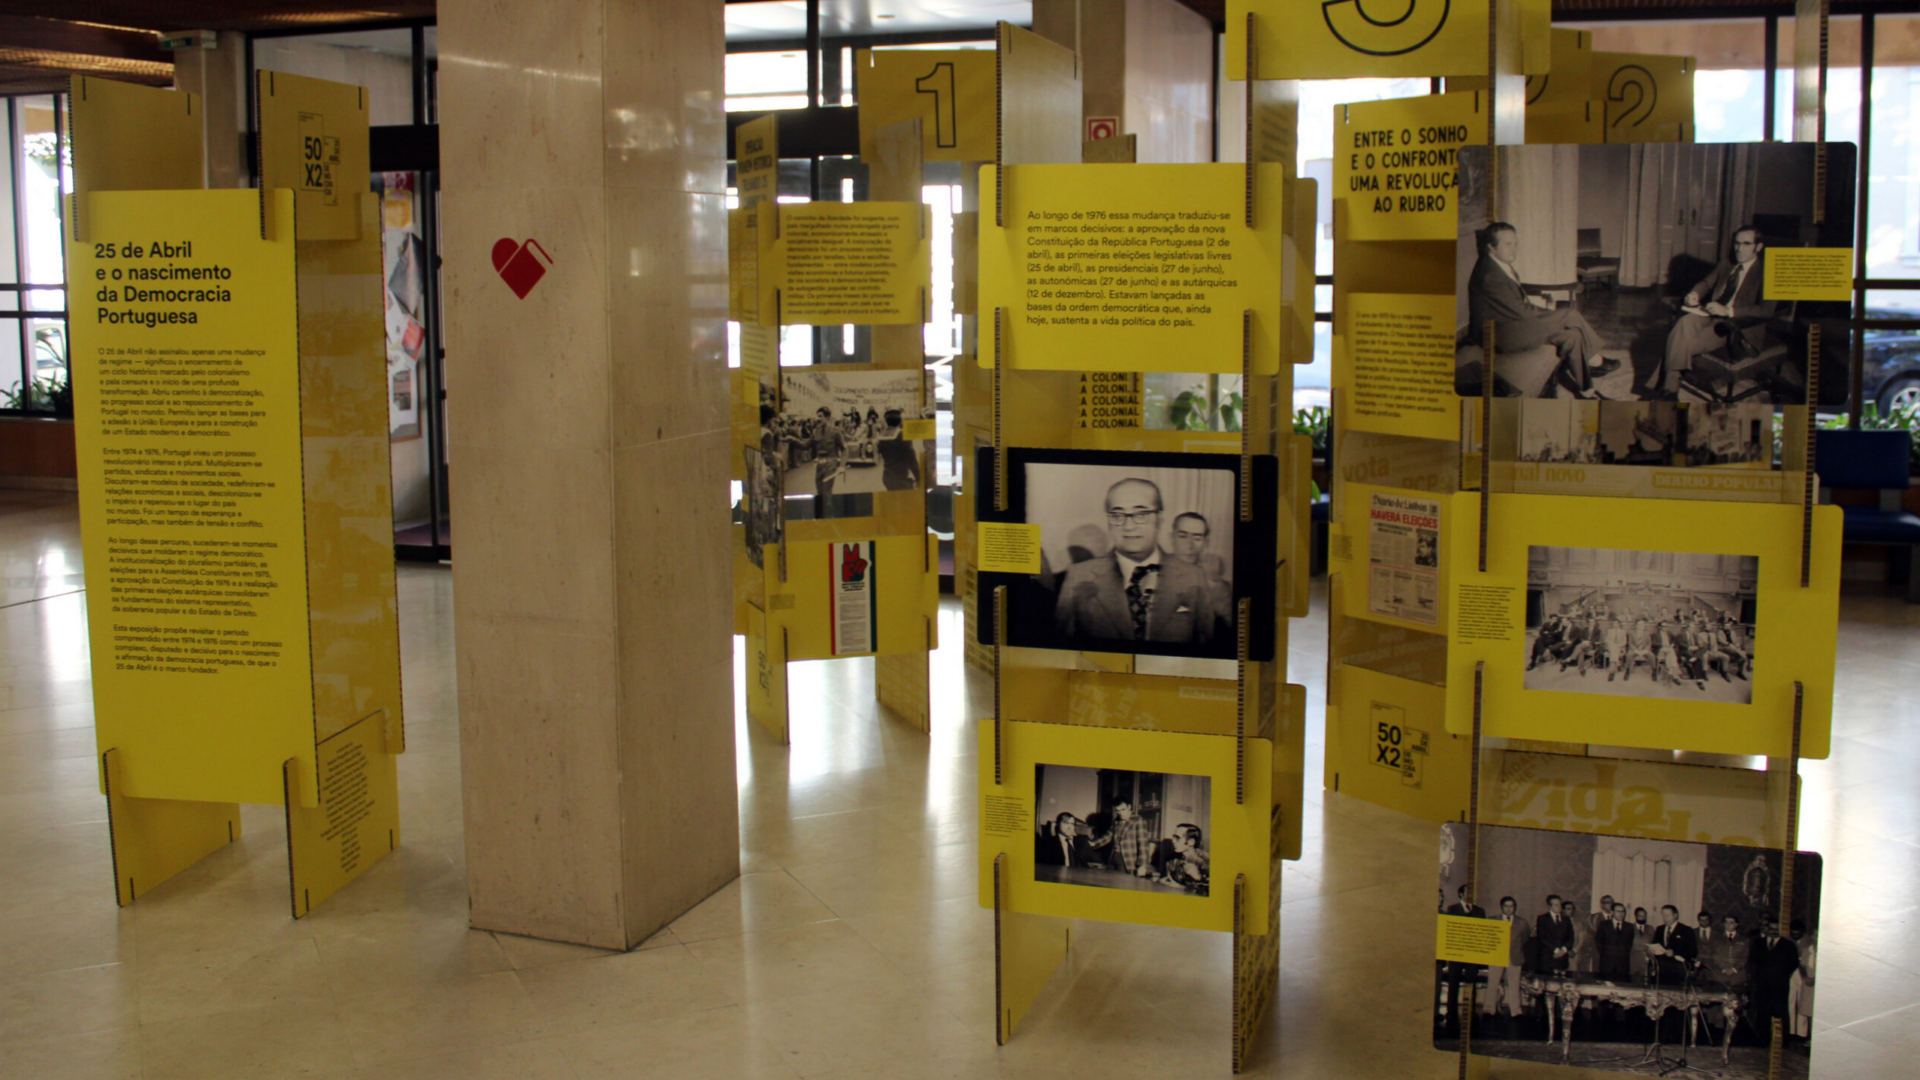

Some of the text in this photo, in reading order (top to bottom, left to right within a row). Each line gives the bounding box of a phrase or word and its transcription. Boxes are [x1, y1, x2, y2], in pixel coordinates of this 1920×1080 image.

[915, 62, 957, 148] 1
[1354, 125, 1467, 148] ENTRE O SONHO
[304, 136, 322, 160] 50
[1351, 148, 1458, 170] E O CONFRONT
[304, 163, 323, 187] X2
[1350, 167, 1458, 193] UMA REVOLUÇÃ
[1373, 195, 1446, 213] AO RUBRO
[1028, 211, 1040, 219] Ao
[1043, 211, 1068, 221] longo
[1071, 211, 1083, 219] de
[1086, 211, 1106, 219] 1976
[1132, 211, 1175, 221] mudança
[1178, 211, 1230, 219] traduziu-se
[1080, 224, 1124, 232] decisivos:
[1136, 224, 1185, 234] aprovação
[1188, 224, 1200, 232] da
[95, 241, 192, 258] 25 de Abril
[1027, 237, 1230, 248] Constituição da República Portuguesa (2 de
[1027, 249, 1052, 259] abril),
[1068, 250, 1110, 260] primeiras
[1112, 251, 1150, 261] eleições
[1154, 251, 1204, 261] legislativas
[1207, 251, 1231, 260] livres
[95, 263, 231, 280] e o nascimento
[1027, 263, 1041, 272] (25
[1043, 264, 1055, 272] de
[1058, 263, 1082, 272] abril),
[1098, 263, 1158, 274] presidenciais
[1162, 263, 1175, 273] (27
[1178, 264, 1190, 272] de
[1192, 264, 1224, 275] junho),
[1039, 276, 1097, 285] autonómicas
[1100, 276, 1114, 286] (27
[1116, 277, 1127, 285] de
[1130, 277, 1158, 287] junho)
[1182, 278, 1237, 288] autárquicas
[96, 285, 231, 302] da Democracia
[1027, 289, 1038, 298] (12
[1041, 290, 1052, 298] de
[1055, 289, 1105, 299] dezembro).
[1109, 290, 1147, 298] Estavam
[1151, 291, 1191, 301] lançadas
[1027, 302, 1211, 314] bases da ordem democrática que, ainda
[98, 307, 198, 328] Portuguesa
[1027, 315, 1048, 325] hoje,
[1051, 316, 1089, 324] sustenta
[1100, 316, 1119, 325] vida
[1122, 317, 1156, 326] política
[1158, 317, 1170, 326] do
[1092, 396, 1139, 405] COLONIAL
[1092, 408, 1139, 417] COLONIAL
[1092, 419, 1139, 428] COLONIAL
[1377, 722, 1402, 745] 50
[1376, 743, 1401, 768] X2
